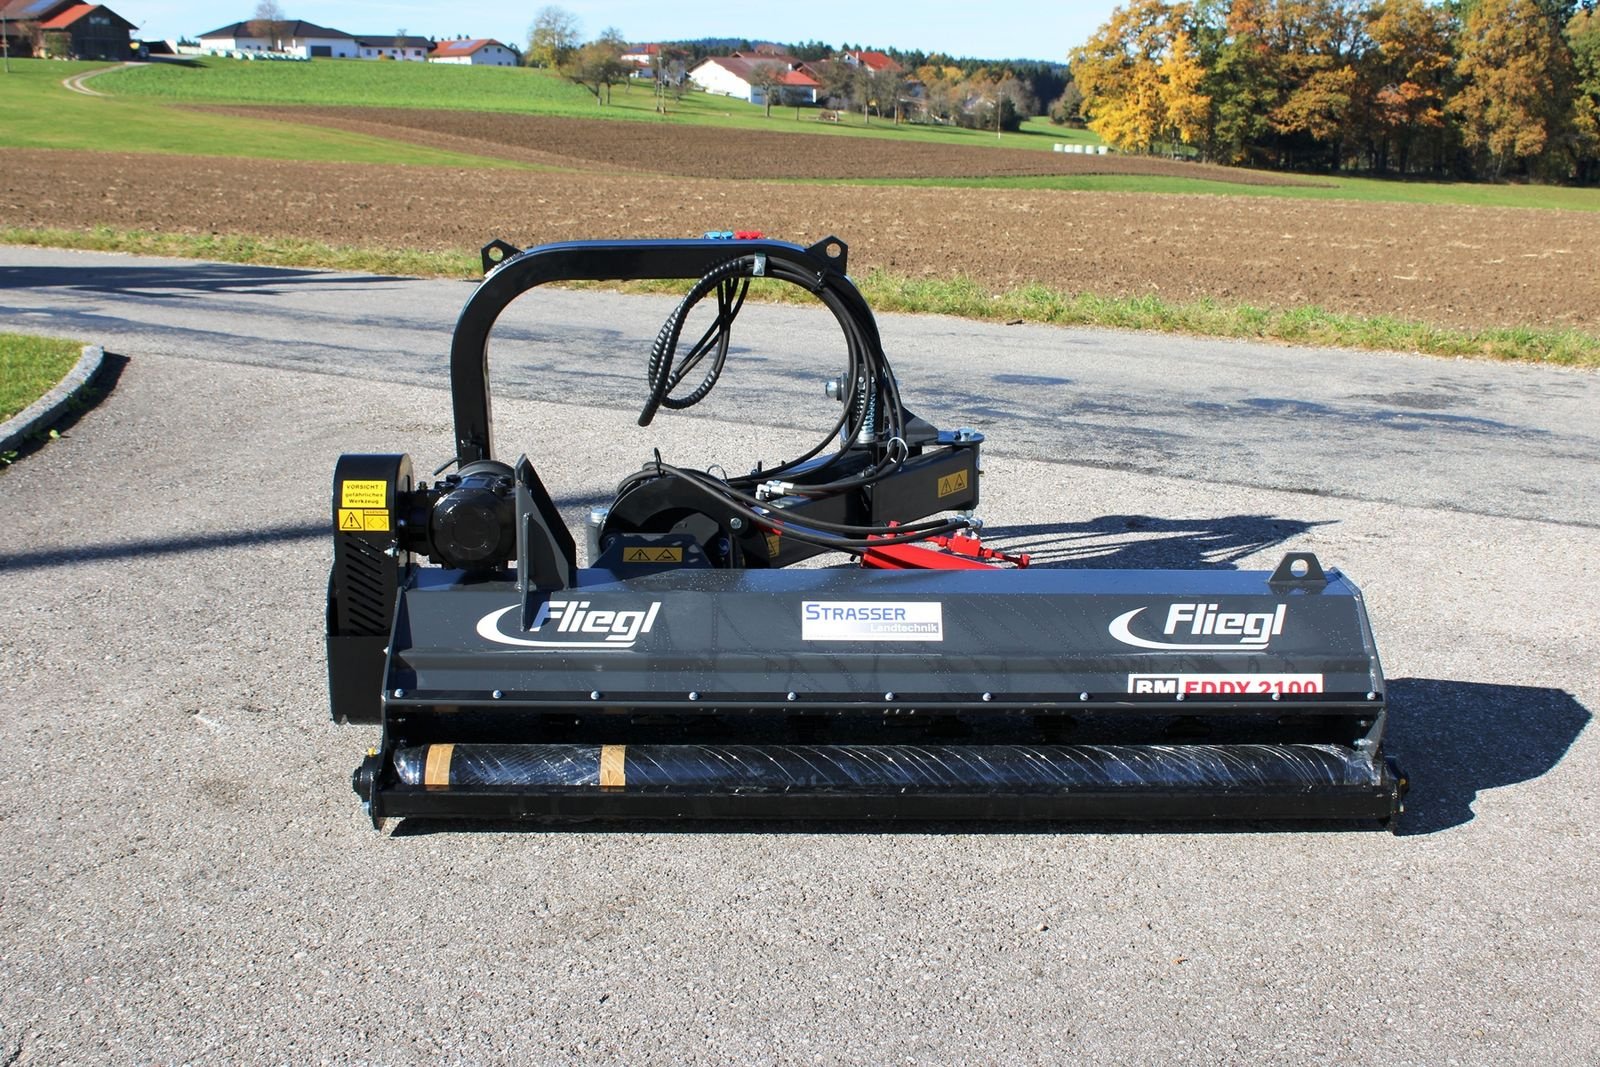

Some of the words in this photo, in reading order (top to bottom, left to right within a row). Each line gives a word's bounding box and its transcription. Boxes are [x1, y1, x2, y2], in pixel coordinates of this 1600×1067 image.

[806, 604, 906, 620] STRASSER
[528, 601, 662, 641] Fliegl
[870, 623, 938, 632] Landtechnik
[1163, 603, 1288, 643] Fliegl
[1136, 680, 1177, 693] RM
[1185, 681, 1251, 694] EDDY
[1258, 681, 1318, 694] 2100
